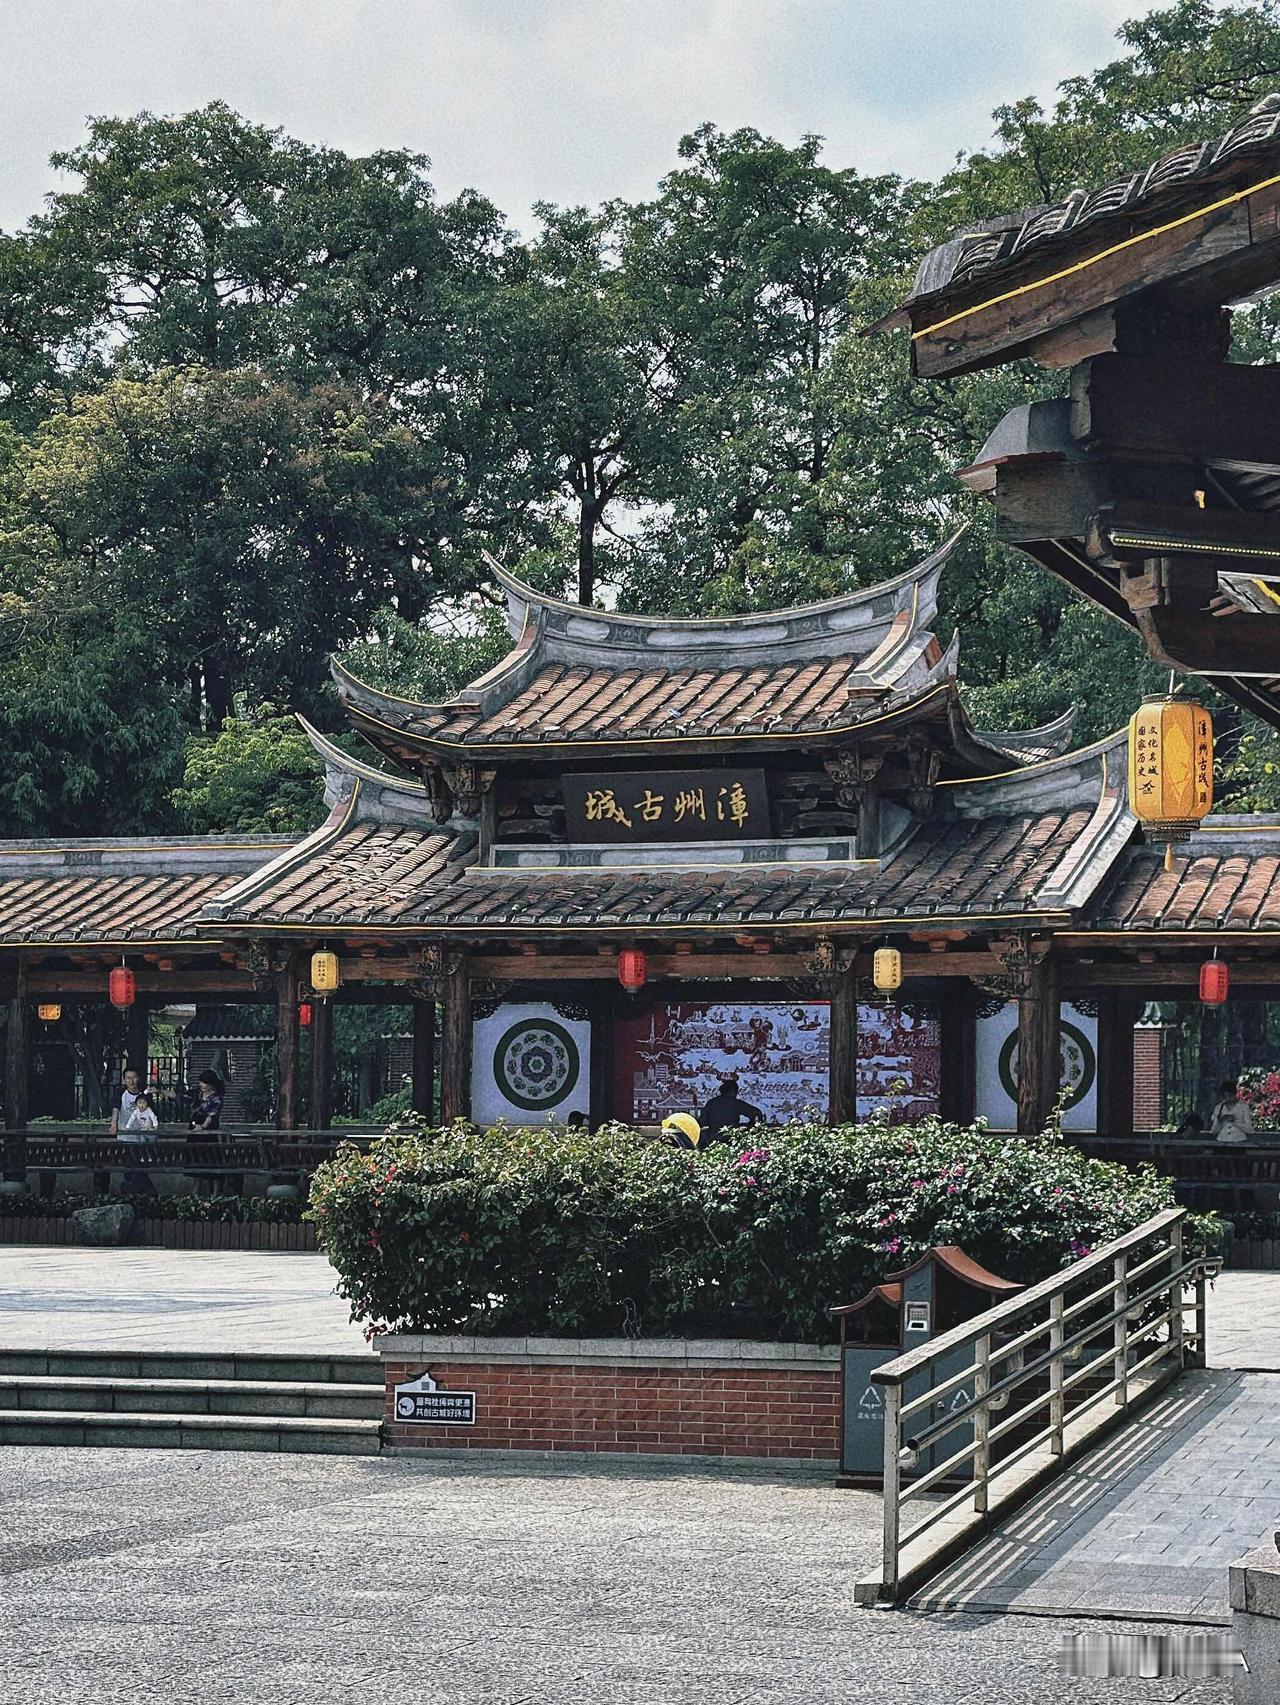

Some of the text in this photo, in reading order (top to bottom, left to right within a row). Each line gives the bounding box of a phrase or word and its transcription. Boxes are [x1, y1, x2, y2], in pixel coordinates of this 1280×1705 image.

[1137, 726, 1147, 777] 国家历史
[1147, 726, 1159, 776] 文化名城
[1199, 720, 1209, 788] 漳州古城
[416, 1408, 471, 1418] 共创古城好环境
